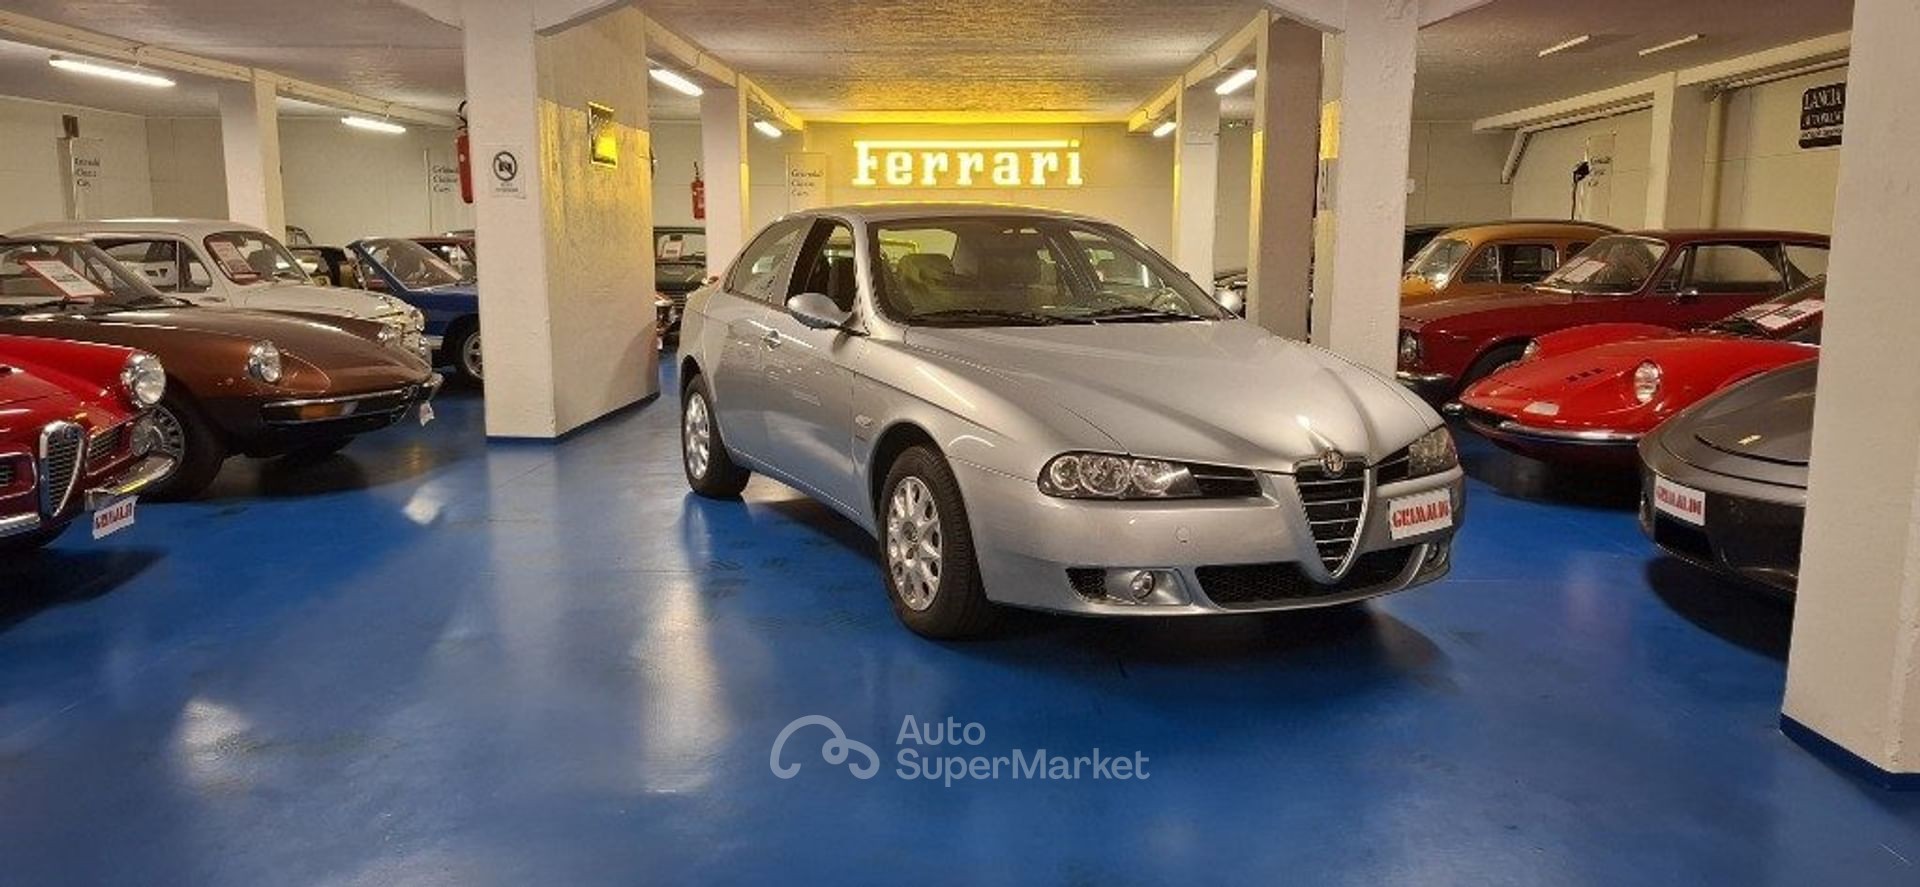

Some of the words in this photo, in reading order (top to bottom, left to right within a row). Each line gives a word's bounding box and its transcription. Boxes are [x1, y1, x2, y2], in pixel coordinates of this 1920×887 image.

[852, 139, 1083, 186] Ferrari
[1392, 500, 1449, 528] GRIMALDI
[1656, 486, 1702, 515] GRIMALDI
